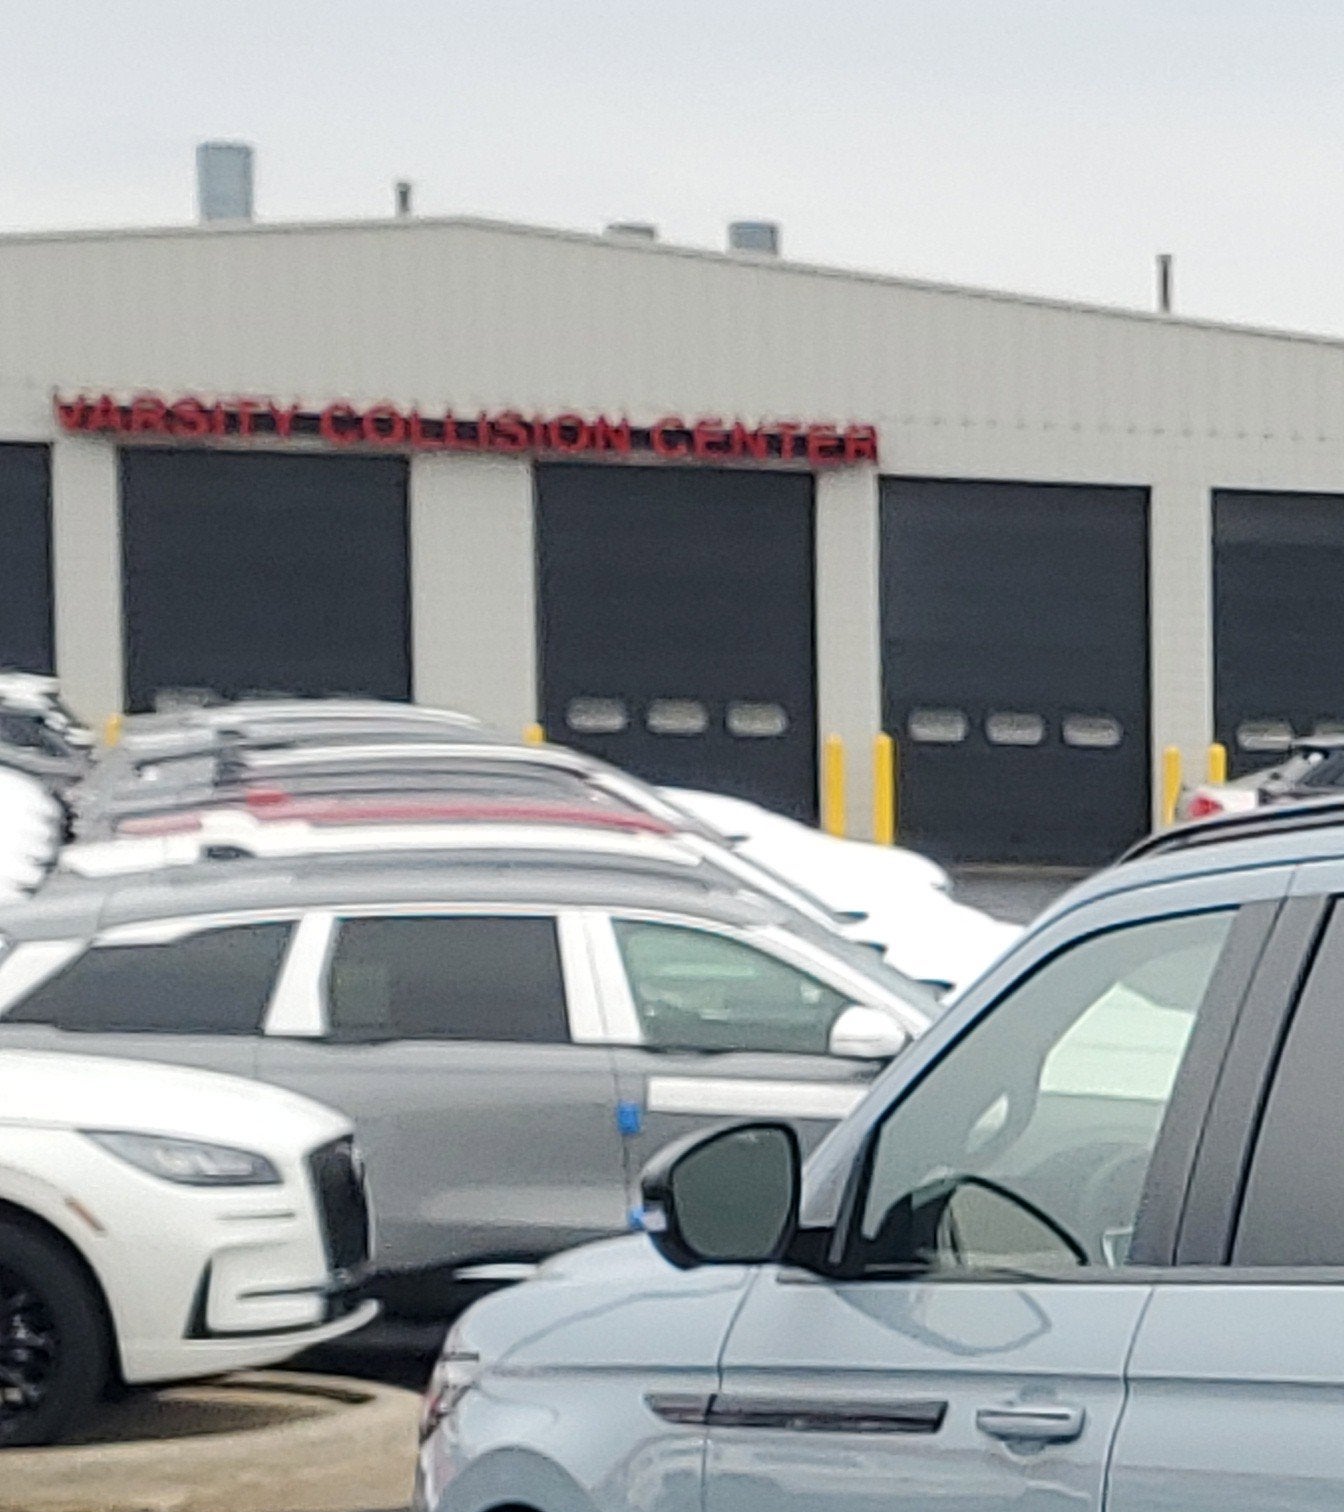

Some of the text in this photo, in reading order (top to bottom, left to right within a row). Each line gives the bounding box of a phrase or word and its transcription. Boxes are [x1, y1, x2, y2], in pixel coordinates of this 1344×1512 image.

[53, 390, 878, 465] VARSITY COLLISION CENTER
